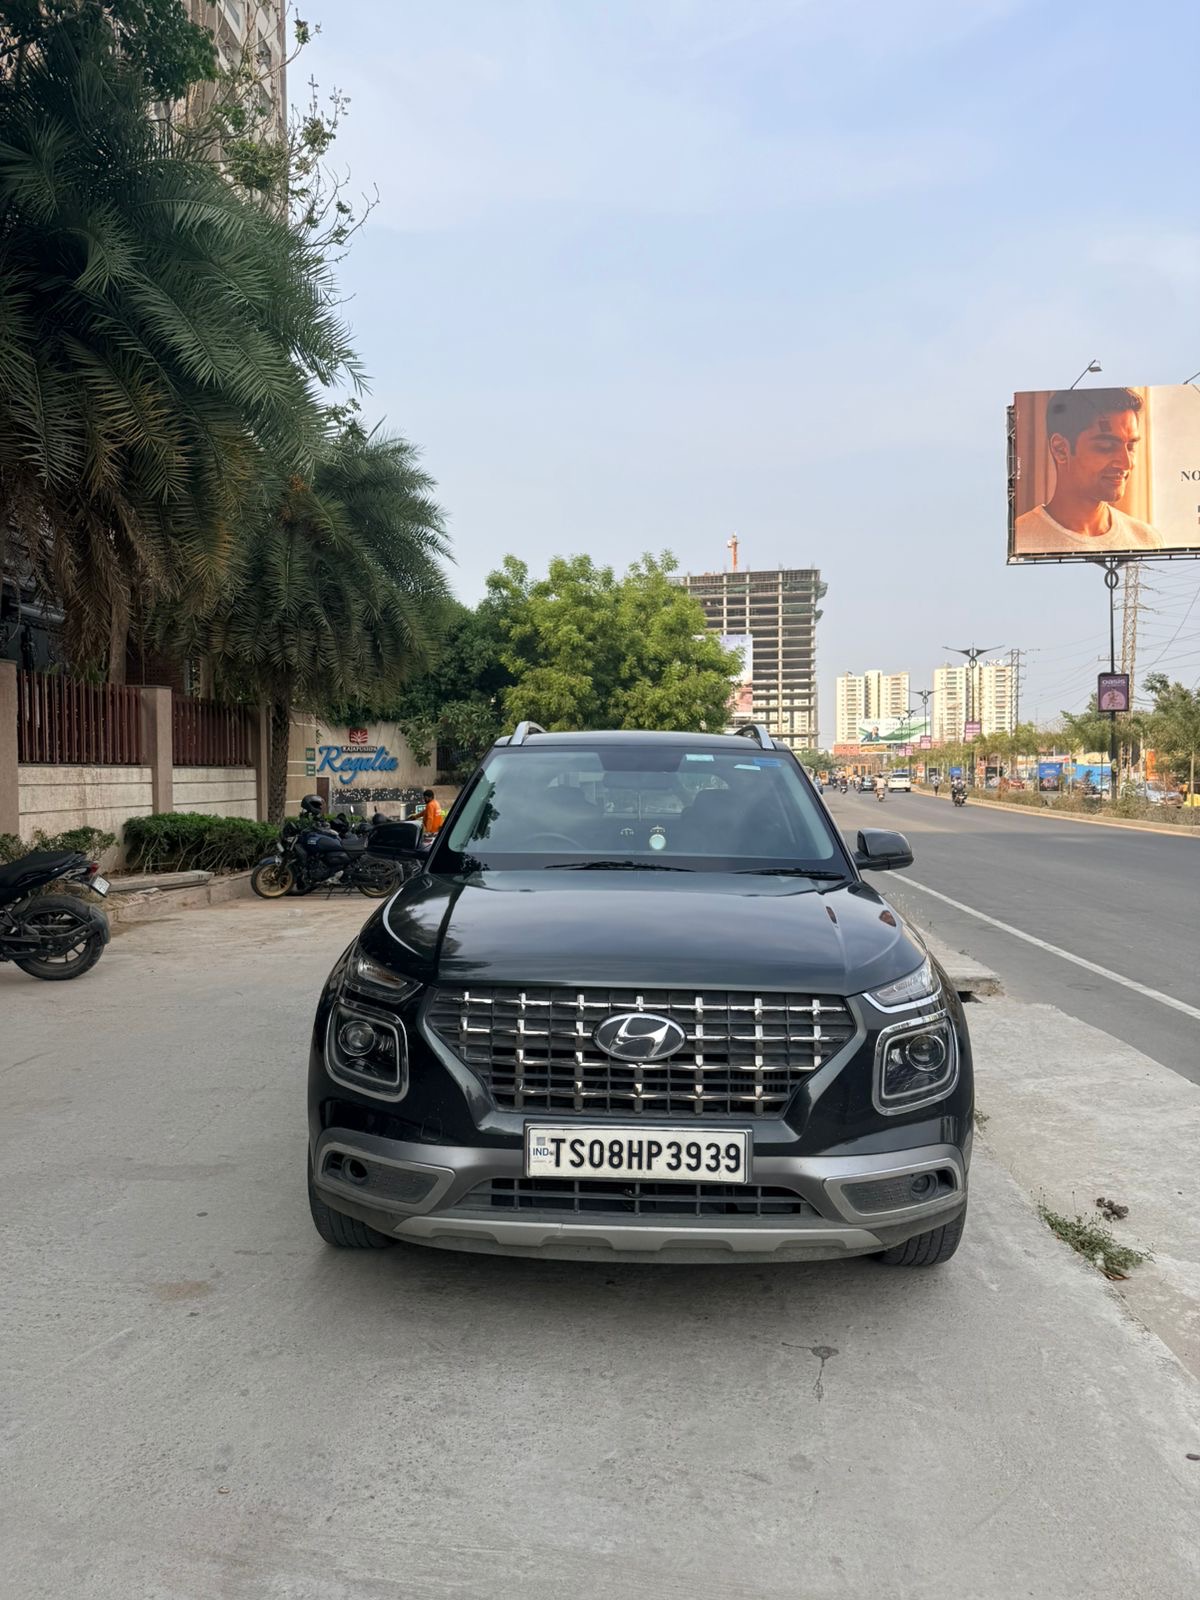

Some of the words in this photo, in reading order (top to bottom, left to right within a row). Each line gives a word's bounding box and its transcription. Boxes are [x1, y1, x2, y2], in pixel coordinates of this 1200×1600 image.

[317, 745, 398, 784] Regalia
[532, 1147, 549, 1156] IND
[550, 1138, 741, 1173] TS08HP3939
